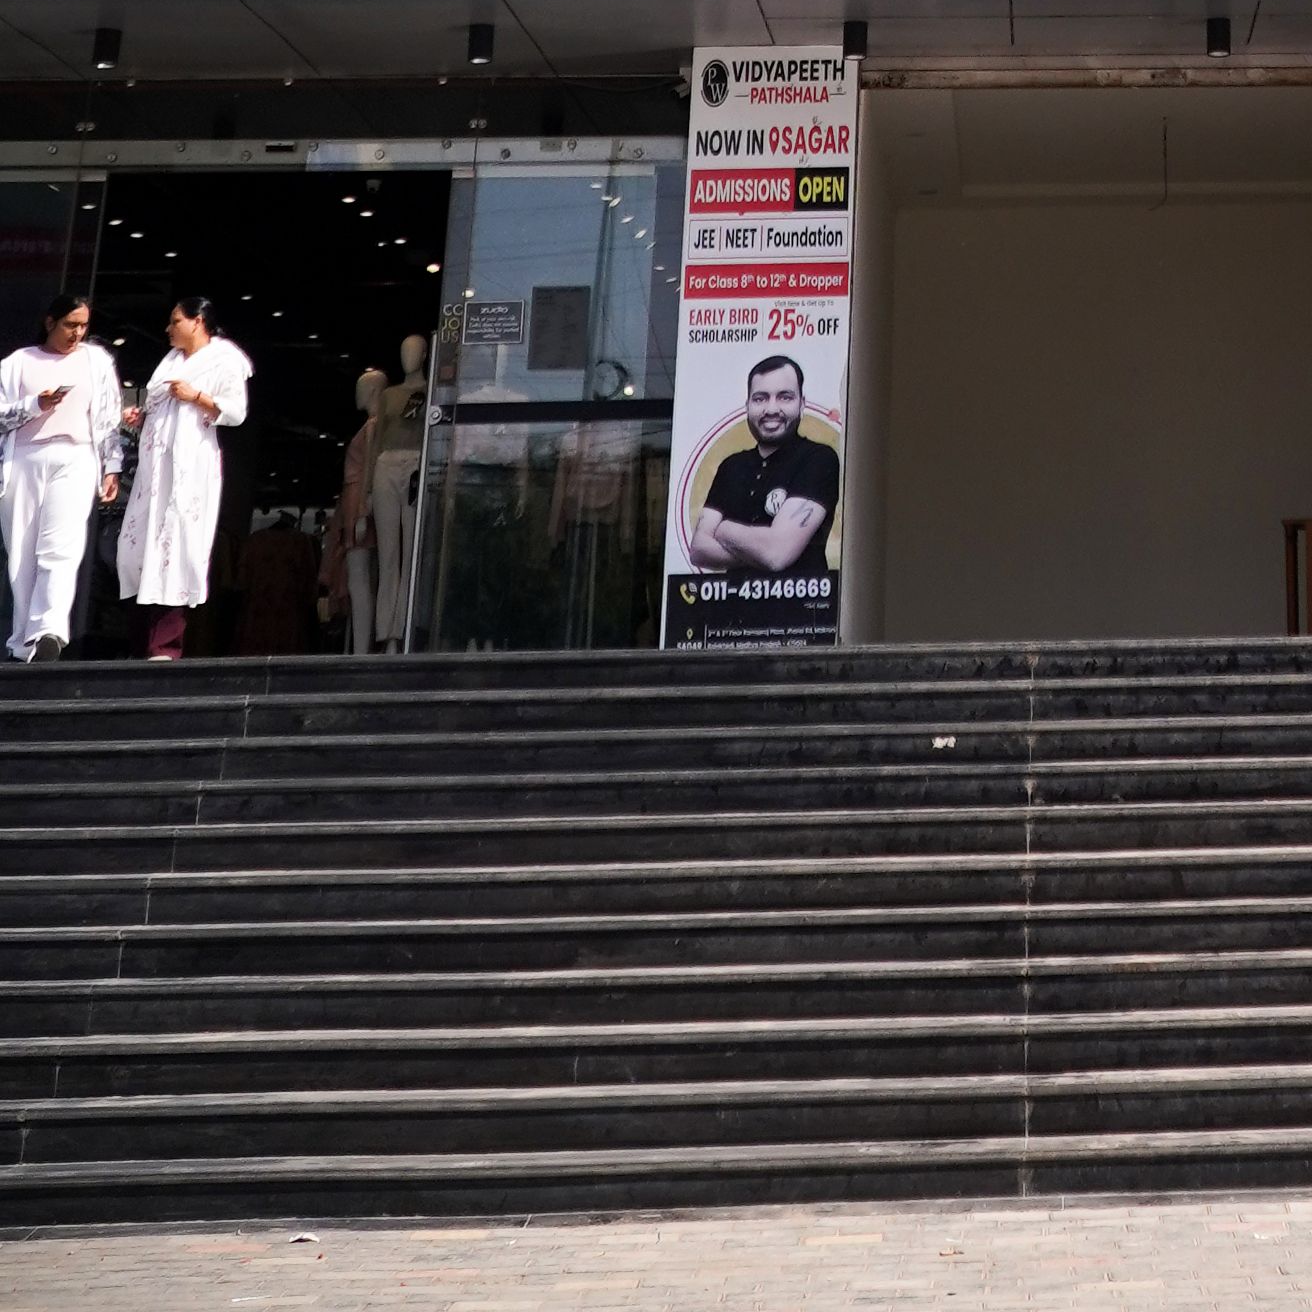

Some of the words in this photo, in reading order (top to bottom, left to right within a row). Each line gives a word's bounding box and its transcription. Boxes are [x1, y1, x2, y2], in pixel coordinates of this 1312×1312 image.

[732, 59, 845, 82] VIDYAPEETH
[750, 86, 829, 104] PATHSHALA
[696, 129, 741, 157] NOW
[746, 128, 764, 156] IN
[781, 125, 849, 155] SAGAR
[694, 177, 791, 204] ADMISSIONS
[798, 176, 844, 204] OPEN
[693, 227, 716, 250] JEE
[725, 227, 758, 249] NEET
[766, 224, 843, 248] Foundation
[689, 275, 706, 290] For
[708, 275, 739, 288] Class
[756, 275, 768, 288] to
[788, 275, 796, 287] &
[799, 273, 844, 292] Dropper
[689, 309, 725, 326] EARLY
[729, 308, 759, 325] BIRD
[768, 308, 814, 341] 25%
[817, 318, 839, 336] OFF
[688, 328, 758, 344] SCHOLARSHIP
[700, 578, 831, 602] 011-43146669
